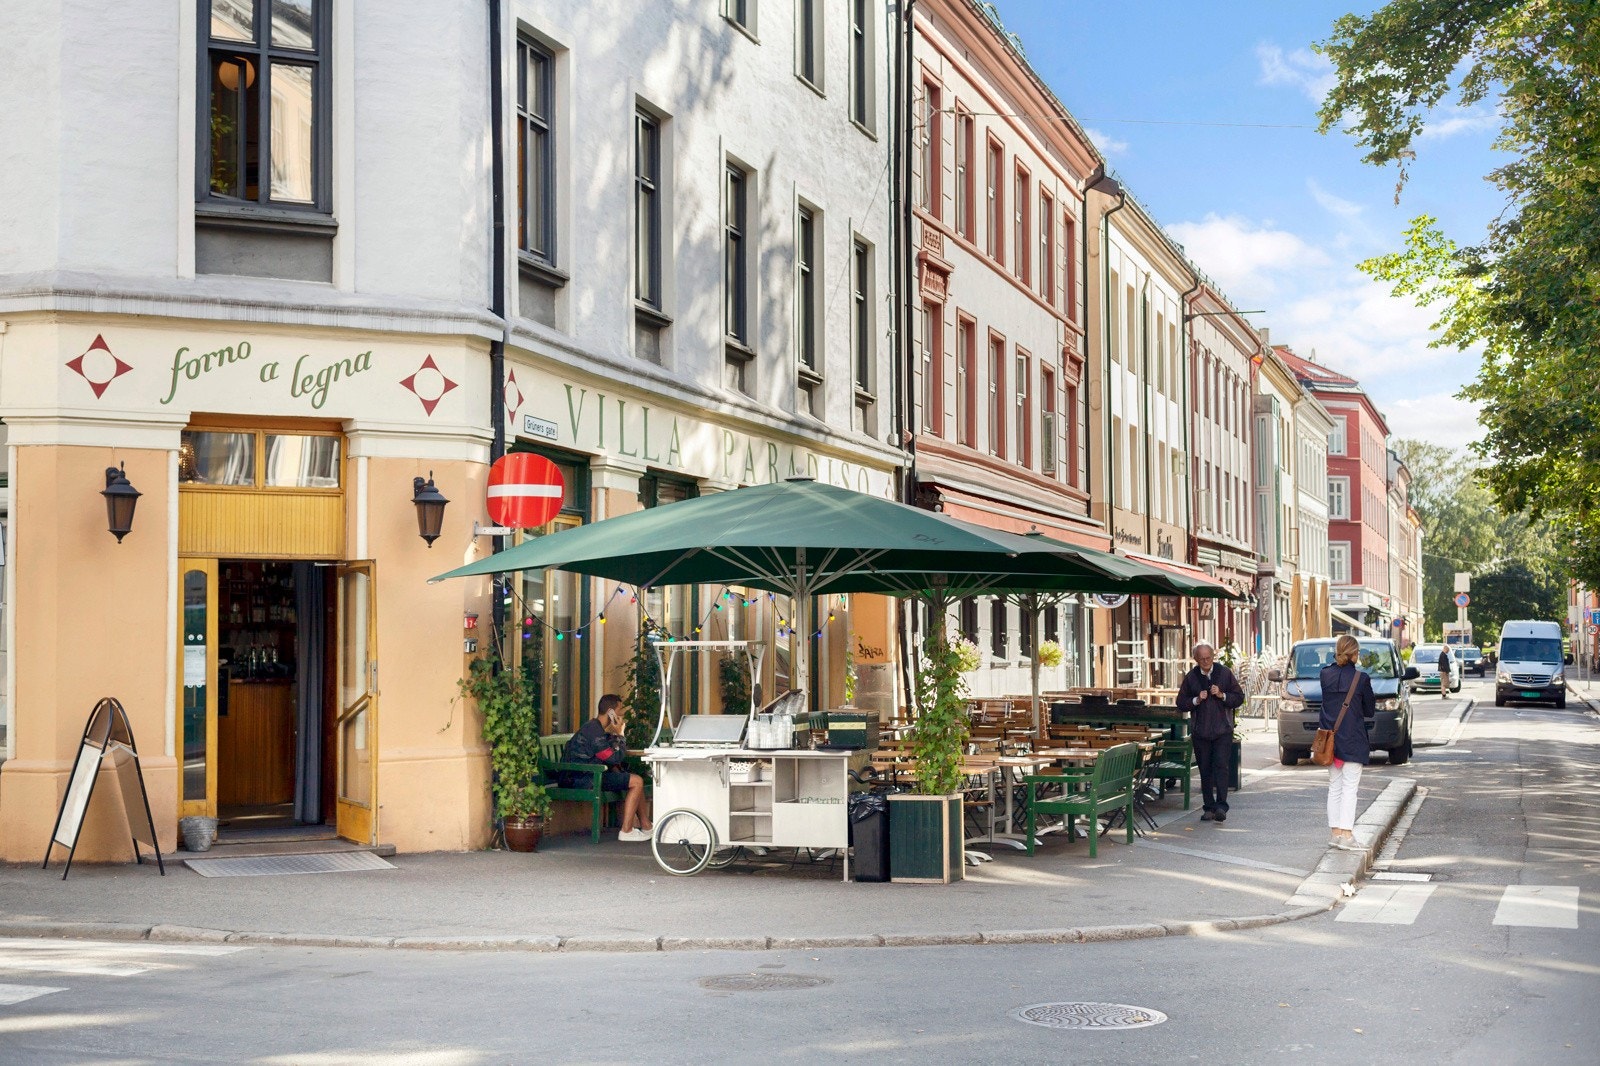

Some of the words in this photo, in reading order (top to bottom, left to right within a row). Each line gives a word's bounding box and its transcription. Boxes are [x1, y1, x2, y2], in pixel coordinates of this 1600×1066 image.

[159, 341, 252, 404] forno
[259, 361, 280, 383] a
[290, 350, 373, 409] legna
[526, 420, 544, 432] Grüners
[546, 426, 556, 436] gate
[563, 383, 685, 468] VILLA
[721, 428, 870, 495] PARADISO
